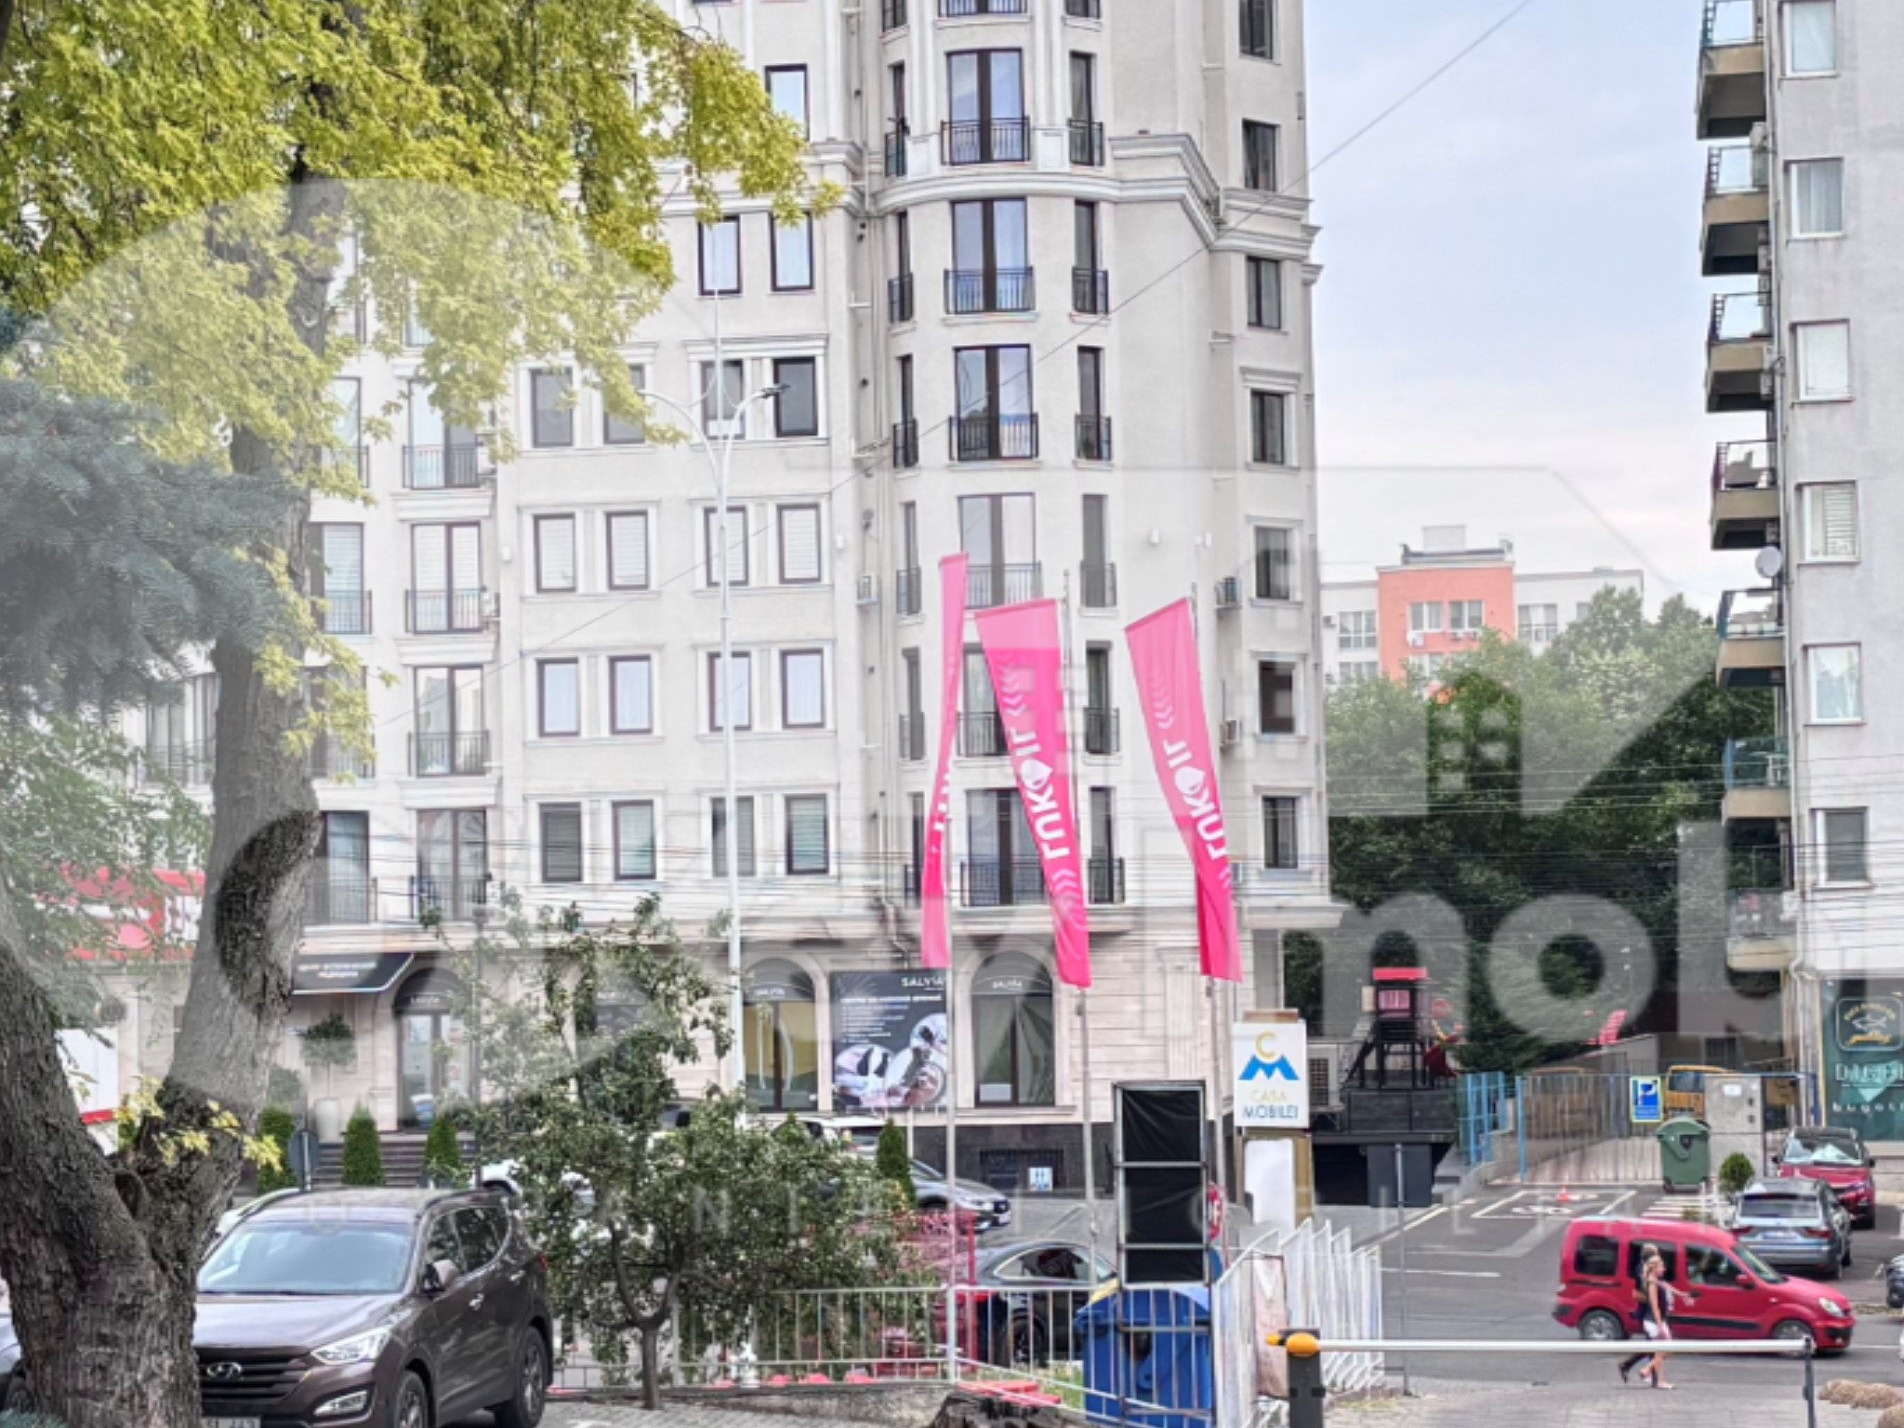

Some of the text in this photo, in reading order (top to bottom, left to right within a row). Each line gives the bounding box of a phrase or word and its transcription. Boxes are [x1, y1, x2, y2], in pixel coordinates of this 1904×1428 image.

[1005, 725, 1071, 860] LUKOIL
[1163, 739, 1227, 861] LUKOIL
[1242, 1104, 1299, 1119] MOBILEI
[1251, 1089, 1287, 1103] CASA
